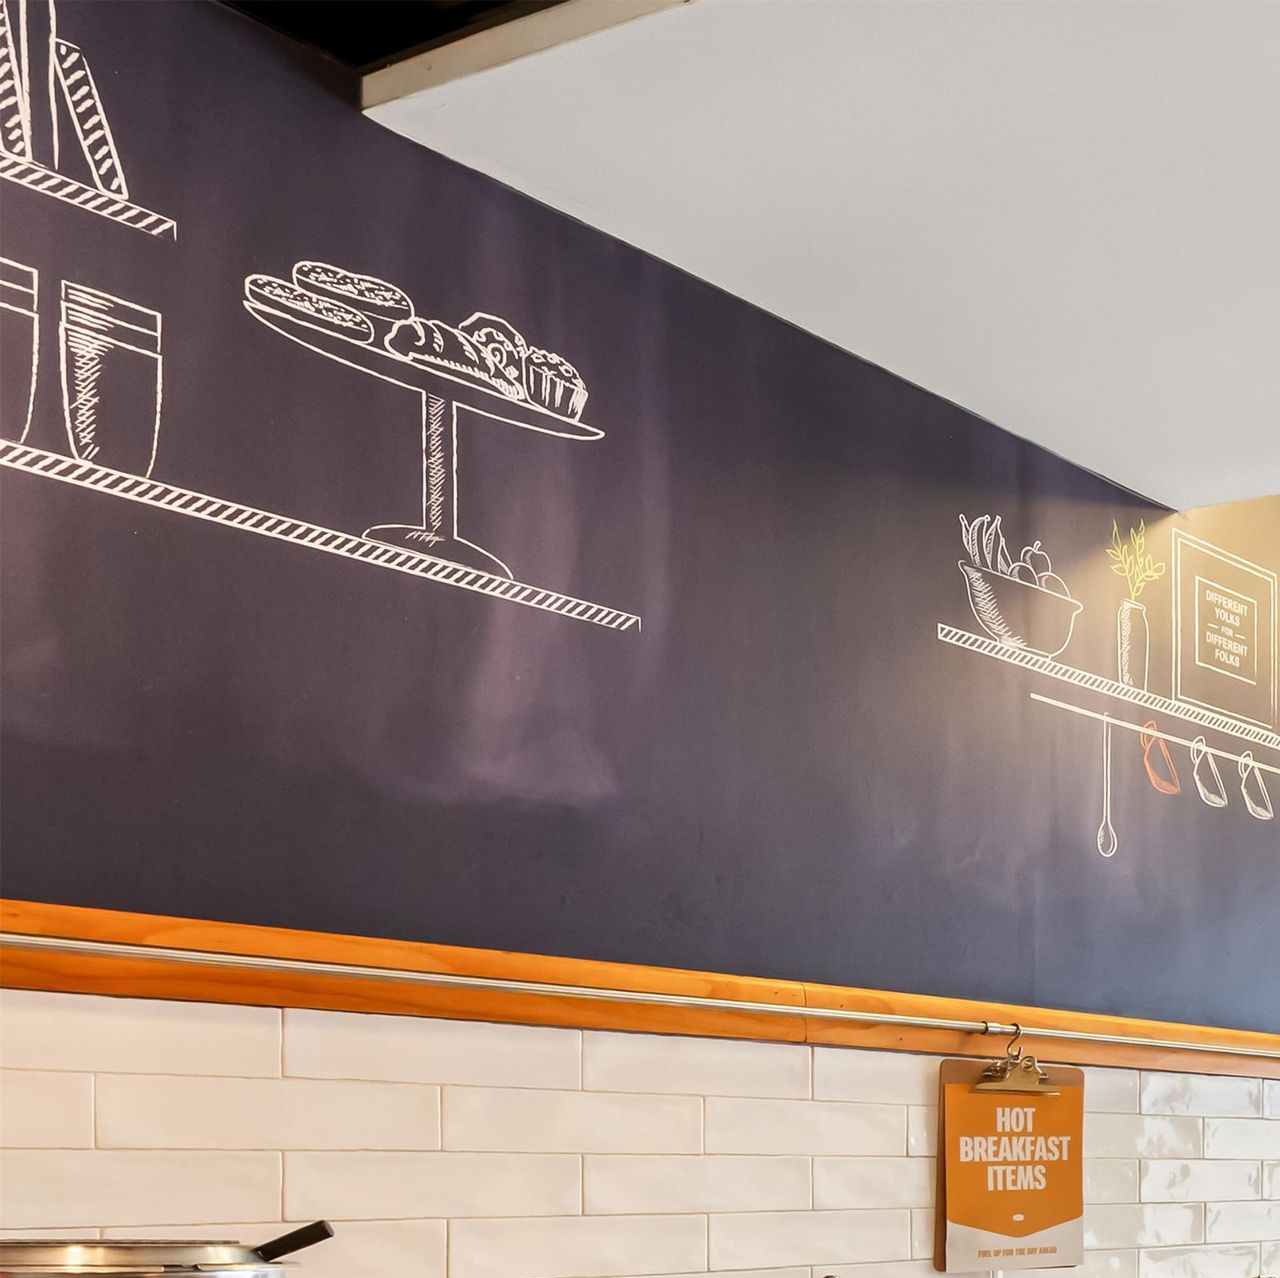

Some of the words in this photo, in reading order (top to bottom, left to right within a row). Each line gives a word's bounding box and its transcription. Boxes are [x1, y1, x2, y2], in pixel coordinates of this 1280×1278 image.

[1205, 589, 1249, 617] DIFFERENT
[1214, 607, 1240, 628] YOLKS
[1205, 631, 1249, 657] DIFFERENT
[1221, 626, 1233, 638] FOR
[1214, 648, 1240, 668] FOLKS
[996, 1107, 1036, 1132] HOT
[959, 1136, 1071, 1162] BREAKFAST
[987, 1165, 1047, 1191] ITEMS
